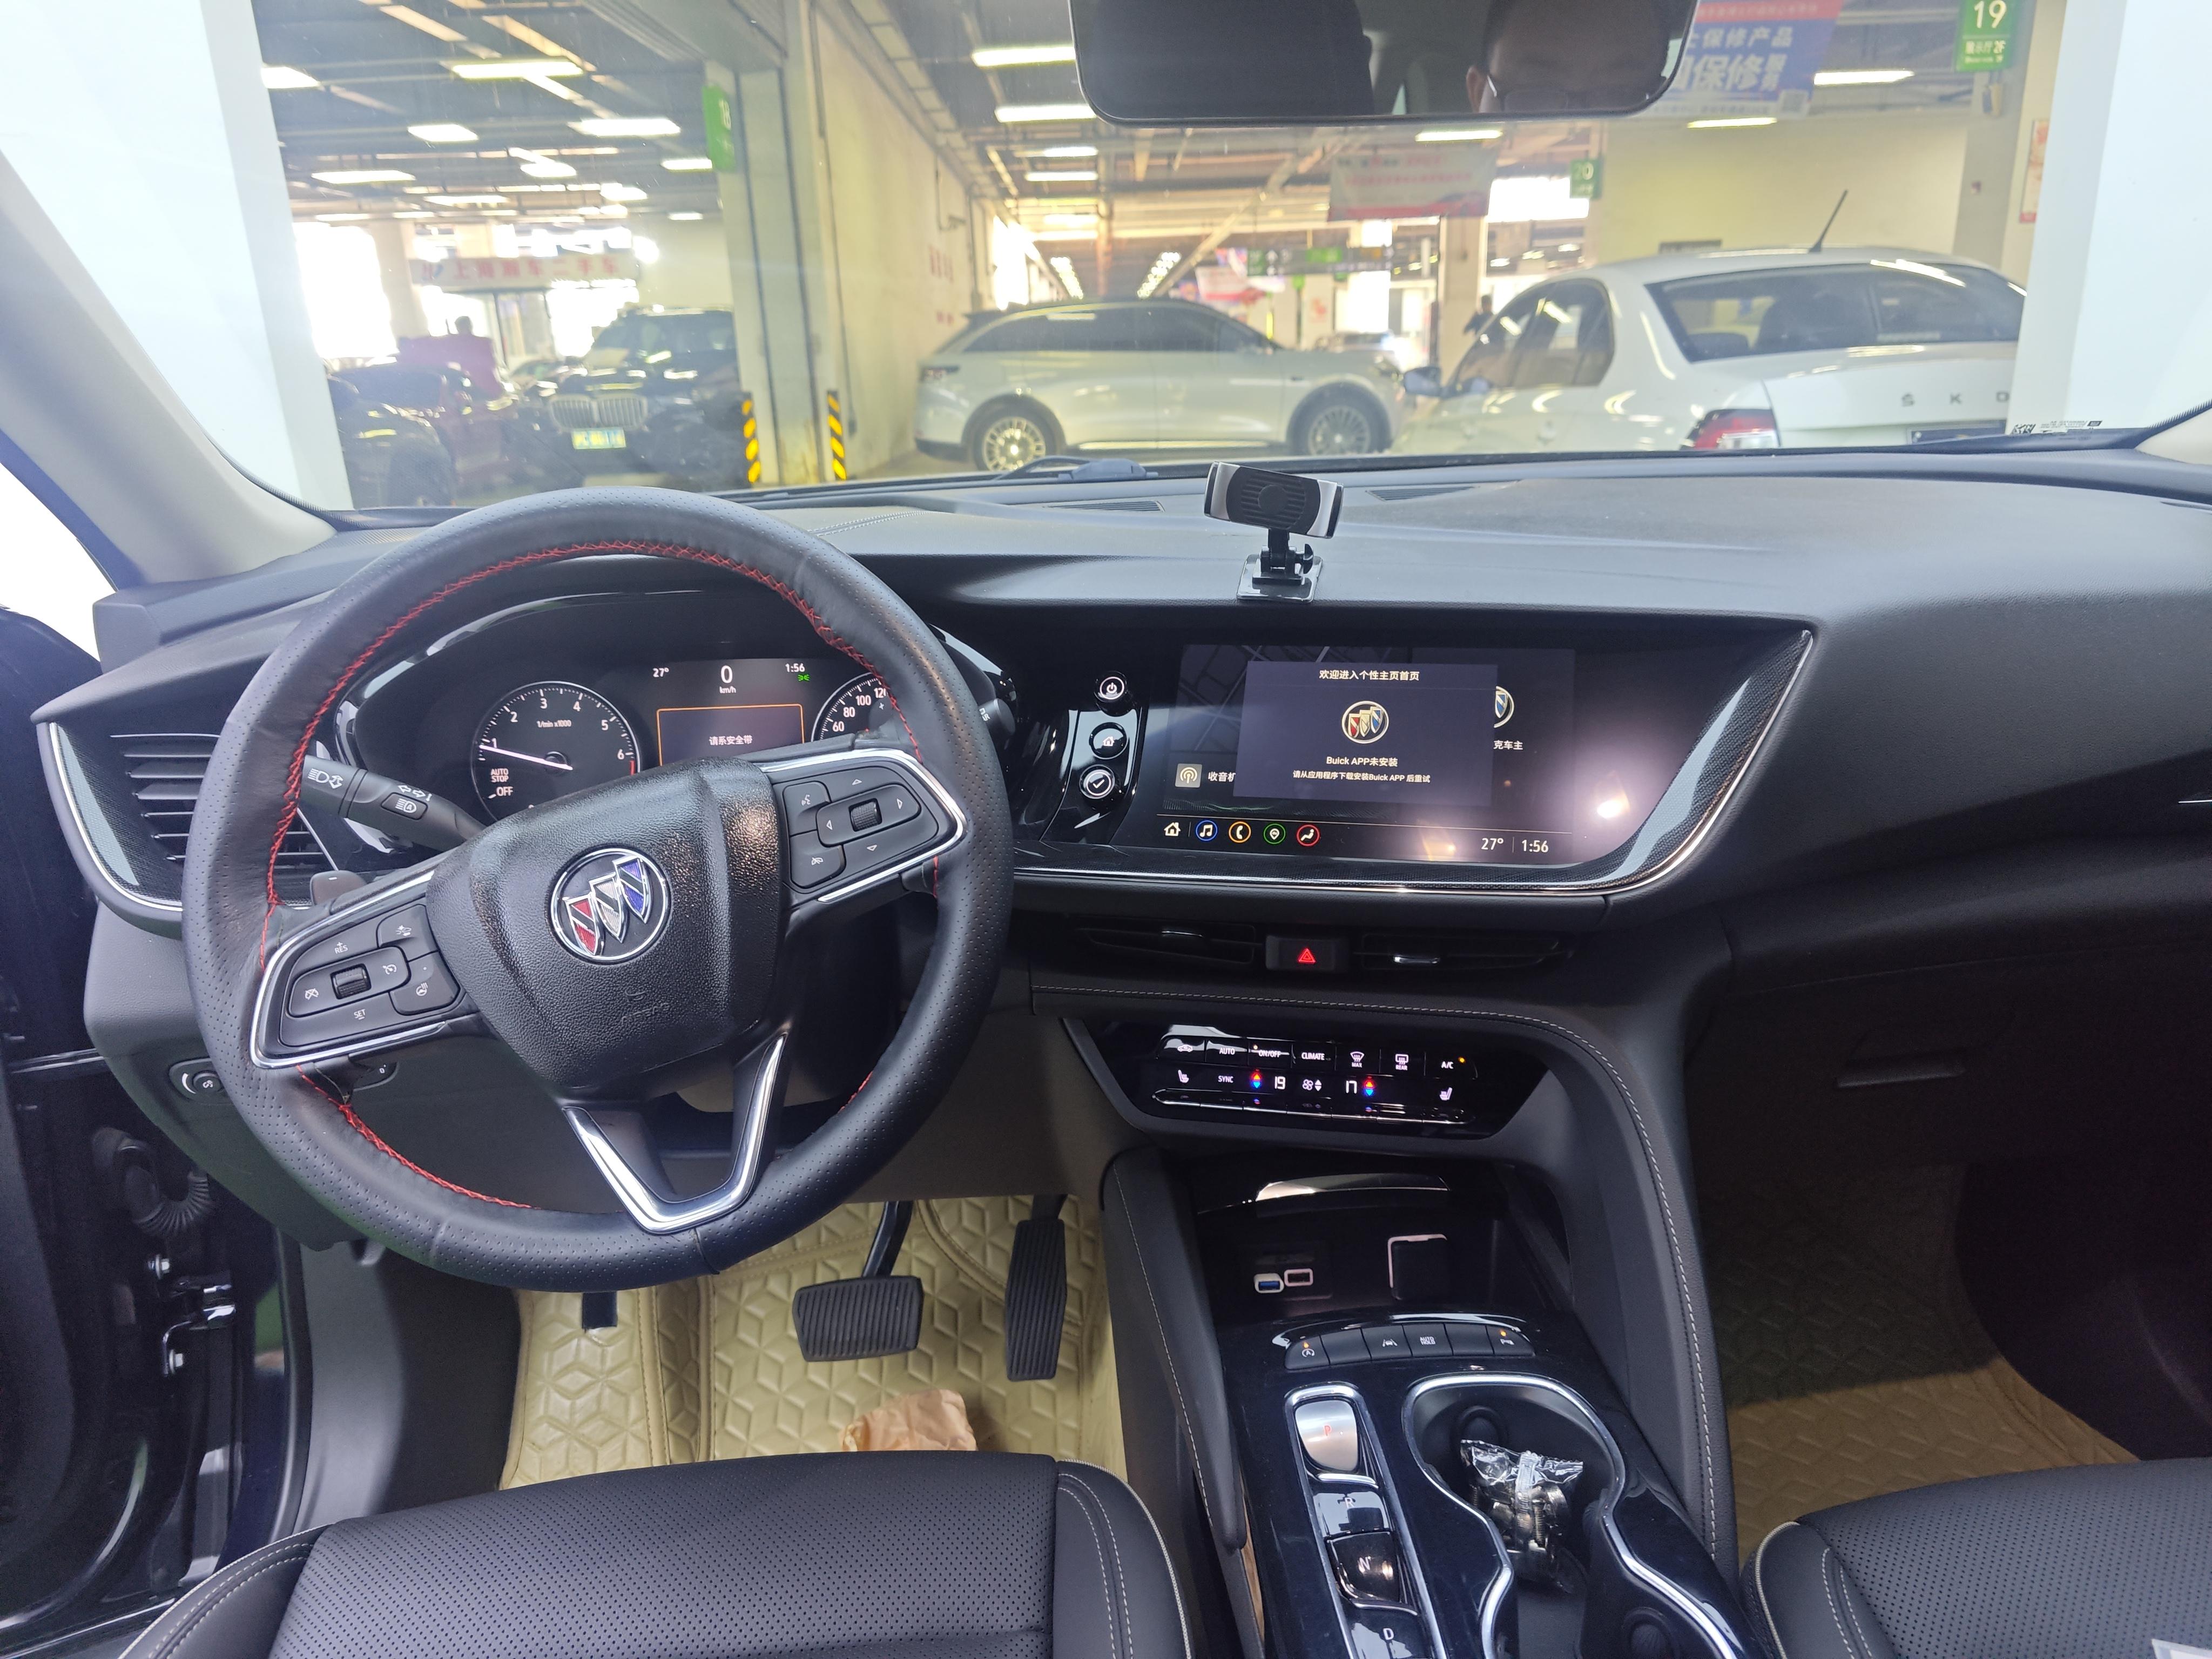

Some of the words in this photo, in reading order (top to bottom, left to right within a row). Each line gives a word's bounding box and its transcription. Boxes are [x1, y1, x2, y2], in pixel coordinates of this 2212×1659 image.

[1974, 0, 2007, 28] 19
[785, 663, 805, 672] 1:56
[720, 665, 733, 684] 0
[1319, 669, 1420, 681] 欢迎进入个性主页首页
[719, 686, 737, 694] km/h
[540, 698, 548, 709] 3
[855, 695, 872, 706] 100
[573, 702, 581, 712] 4
[843, 706, 855, 718] 80
[510, 712, 518, 723] 2
[601, 720, 609, 731] 5
[832, 721, 845, 732] 60
[491, 738, 497, 748] 1
[709, 735, 753, 746] 请系安全带
[1493, 739, 1523, 750] 克车主
[617, 749, 625, 760] 6
[1326, 757, 1349, 765] Buick
[496, 786, 514, 797] OFF
[1522, 839, 1549, 853] 1:56
[334, 945, 348, 954] RES
[354, 1009, 366, 1018] SET
[1258, 1049, 1281, 1058] ON/OFF
[1301, 1052, 1325, 1061] CLIMATE
[1441, 1061, 1454, 1069] A/C
[1218, 1075, 1234, 1083] SYNC
[1274, 1075, 1286, 1090] 19
[1324, 1425, 1332, 1437] P
[1344, 1497, 1354, 1508] R
[1382, 1627, 1394, 1641] D
